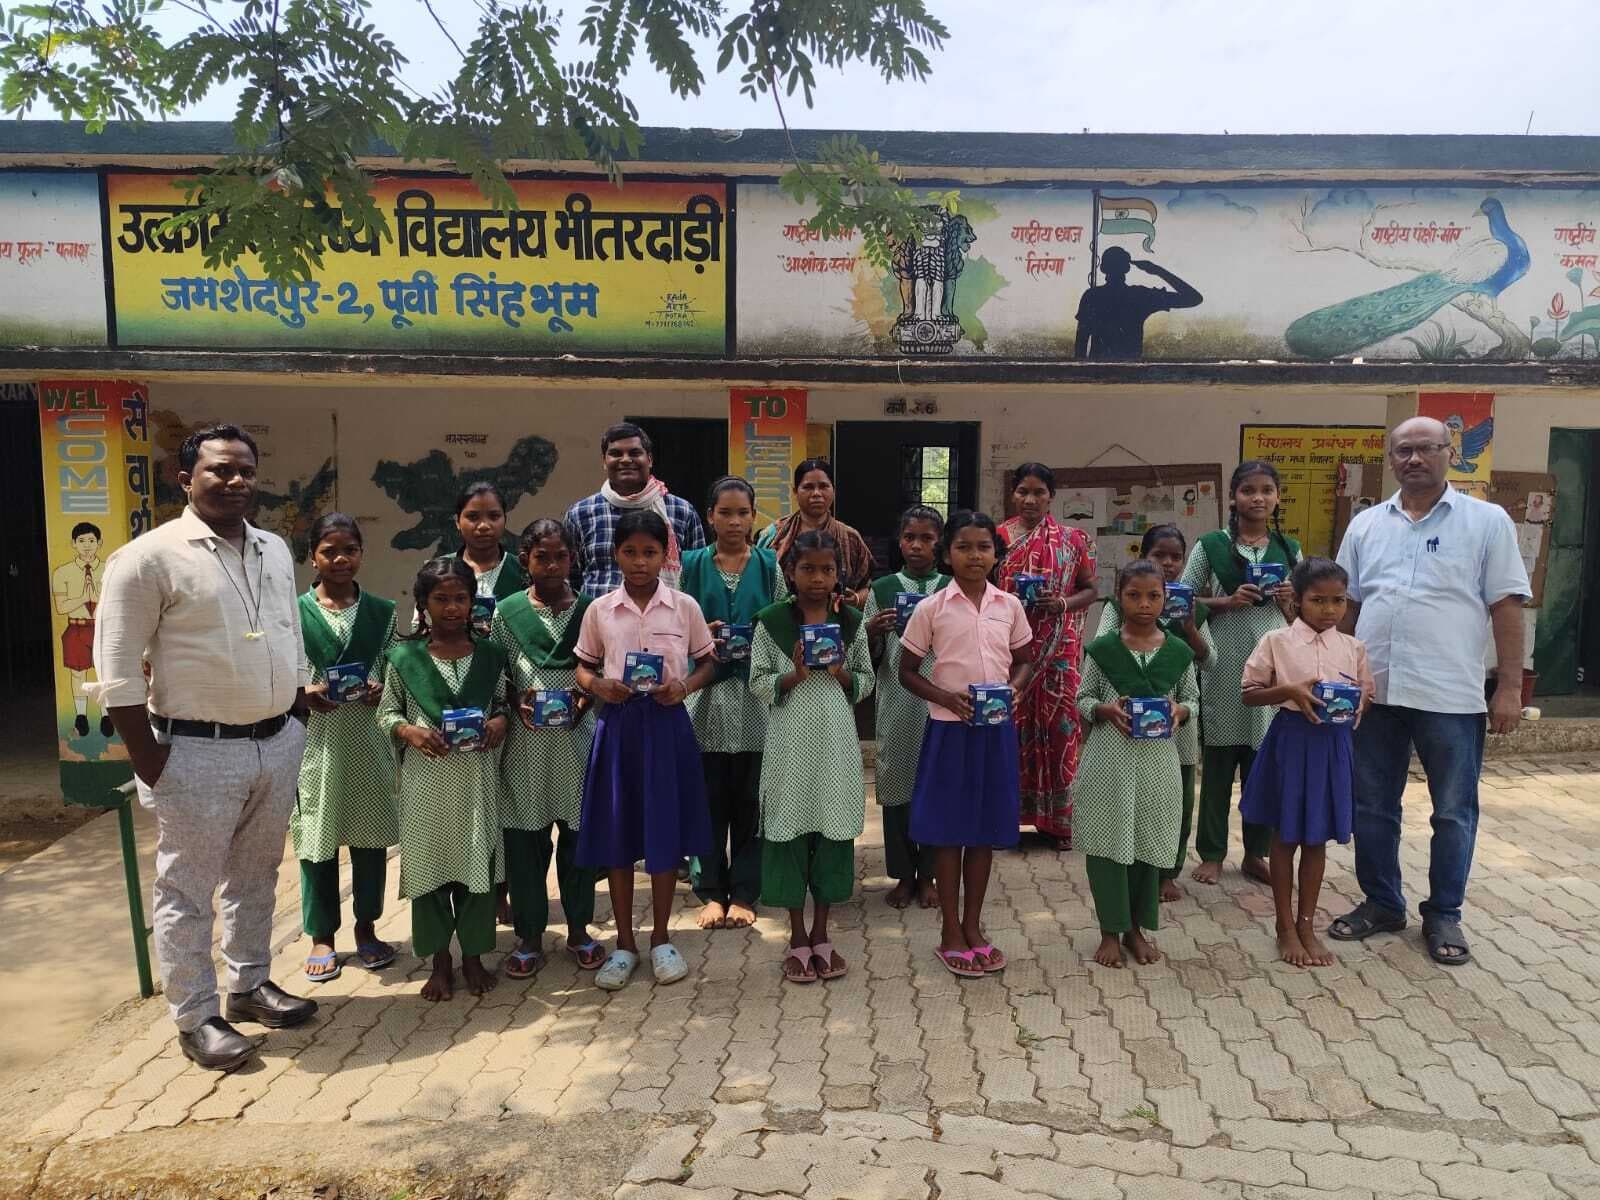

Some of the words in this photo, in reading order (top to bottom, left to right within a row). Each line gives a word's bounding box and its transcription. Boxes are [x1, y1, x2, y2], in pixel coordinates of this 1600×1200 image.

[394, 189, 547, 258] विद्यालय
[555, 192, 723, 274] भीतरदाड़ी
[1055, 226, 1083, 243] ध्वज
[44, 388, 109, 411] WEL
[744, 394, 789, 419] TO
